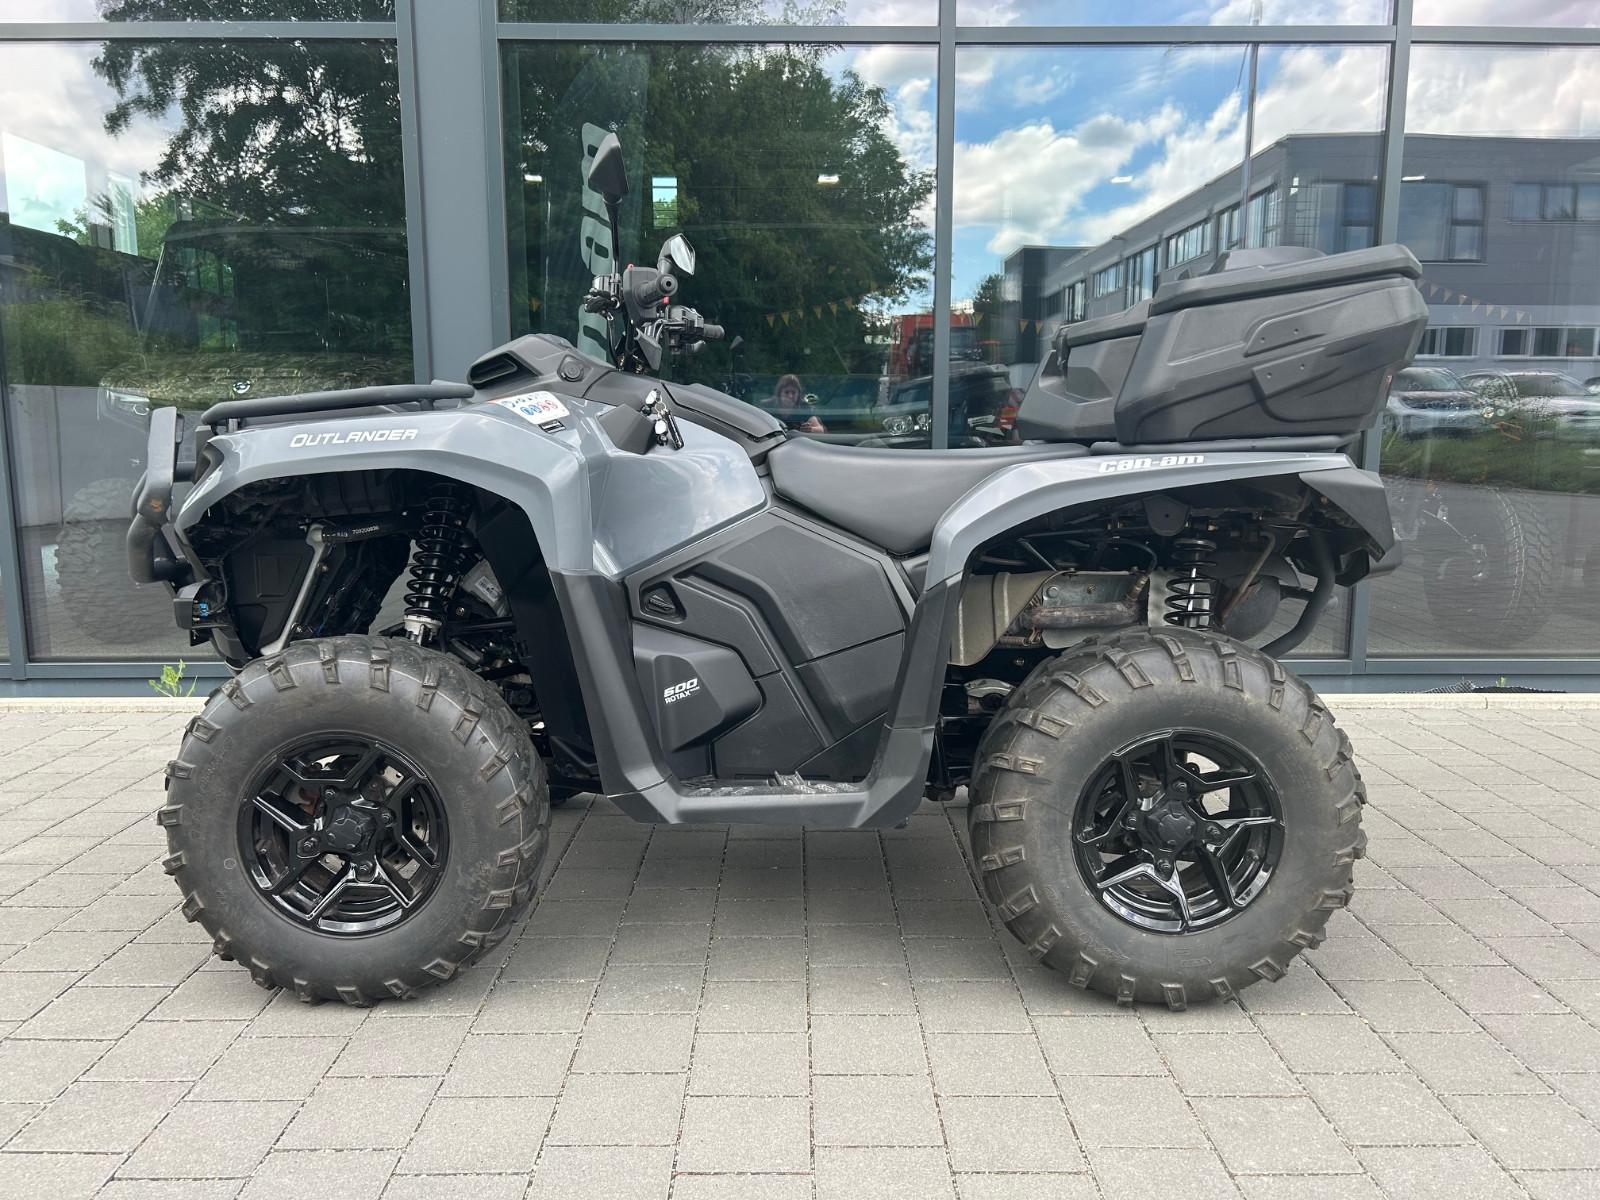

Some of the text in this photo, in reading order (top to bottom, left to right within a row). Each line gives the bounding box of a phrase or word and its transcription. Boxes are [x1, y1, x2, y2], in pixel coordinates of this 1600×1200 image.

[289, 429, 419, 448] OUTLANDER
[1098, 455, 1205, 473] can-am
[664, 690, 691, 704] ROTAX
